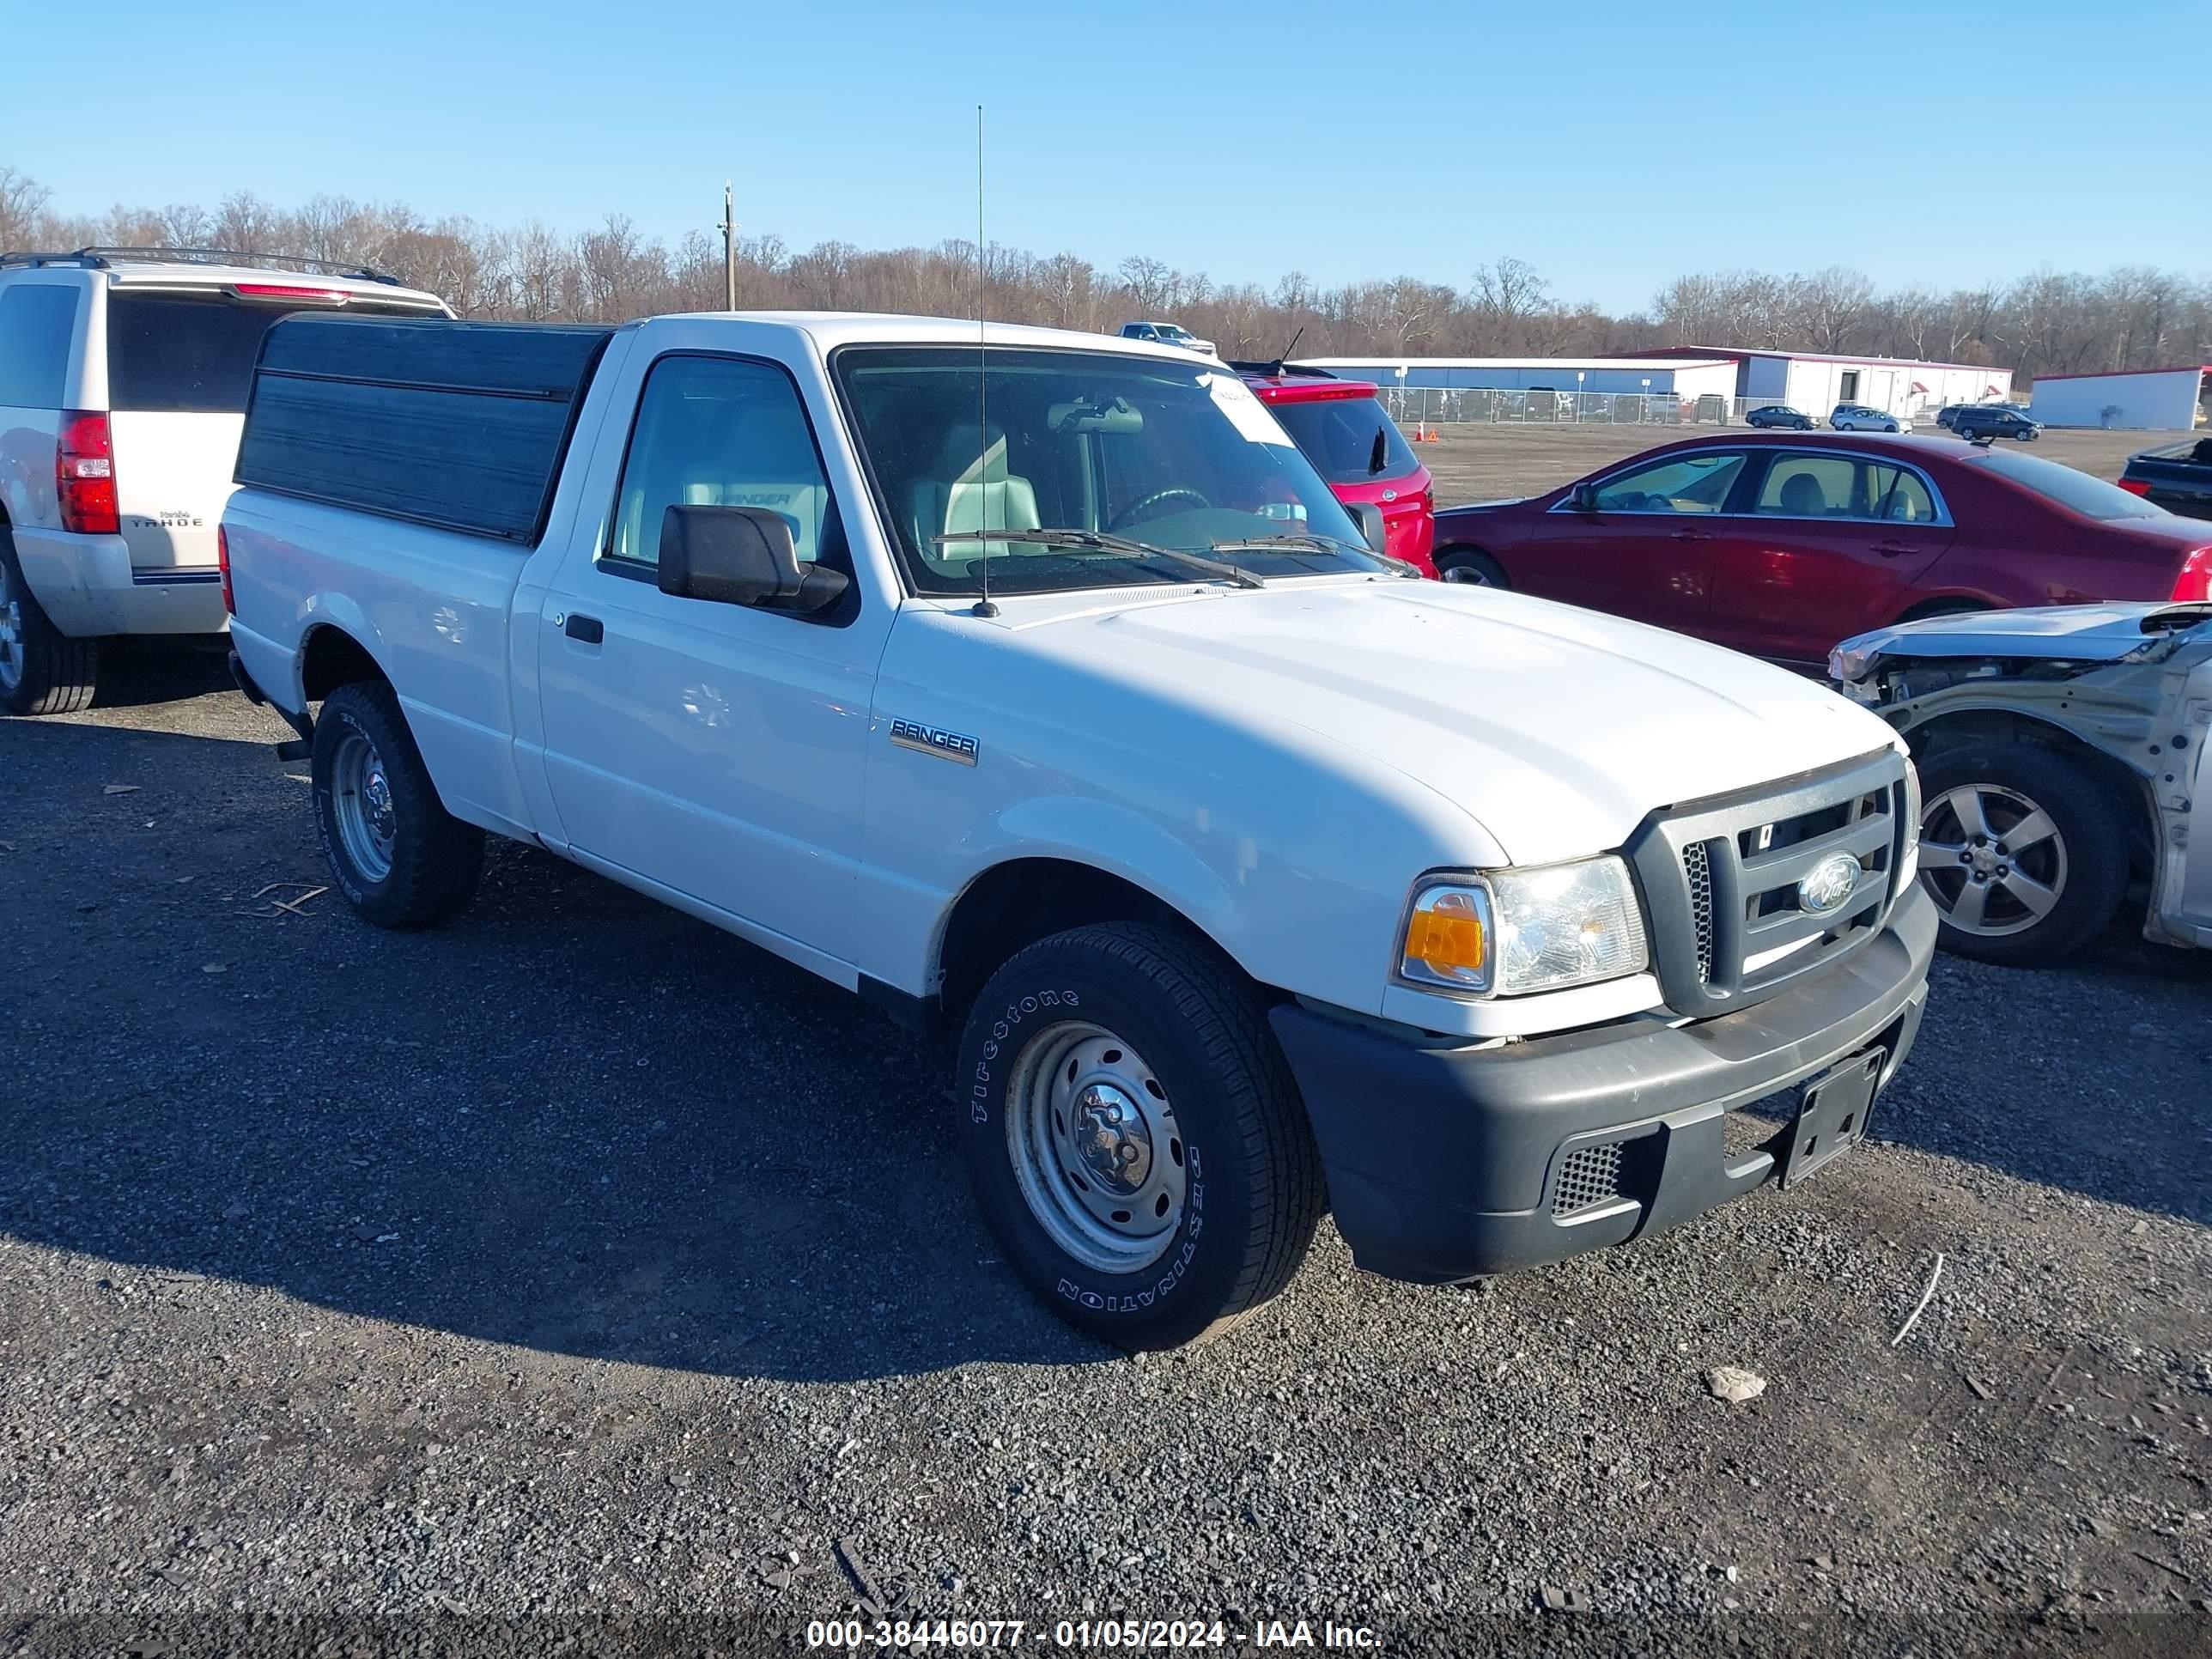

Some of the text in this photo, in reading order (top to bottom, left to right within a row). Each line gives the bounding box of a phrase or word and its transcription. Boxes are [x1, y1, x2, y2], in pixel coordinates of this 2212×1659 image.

[132, 518, 204, 528] TAHOE
[890, 720, 976, 756] RANGER
[971, 989, 1079, 1123] Firestone
[1057, 1146, 1204, 1312] DESTINATION
